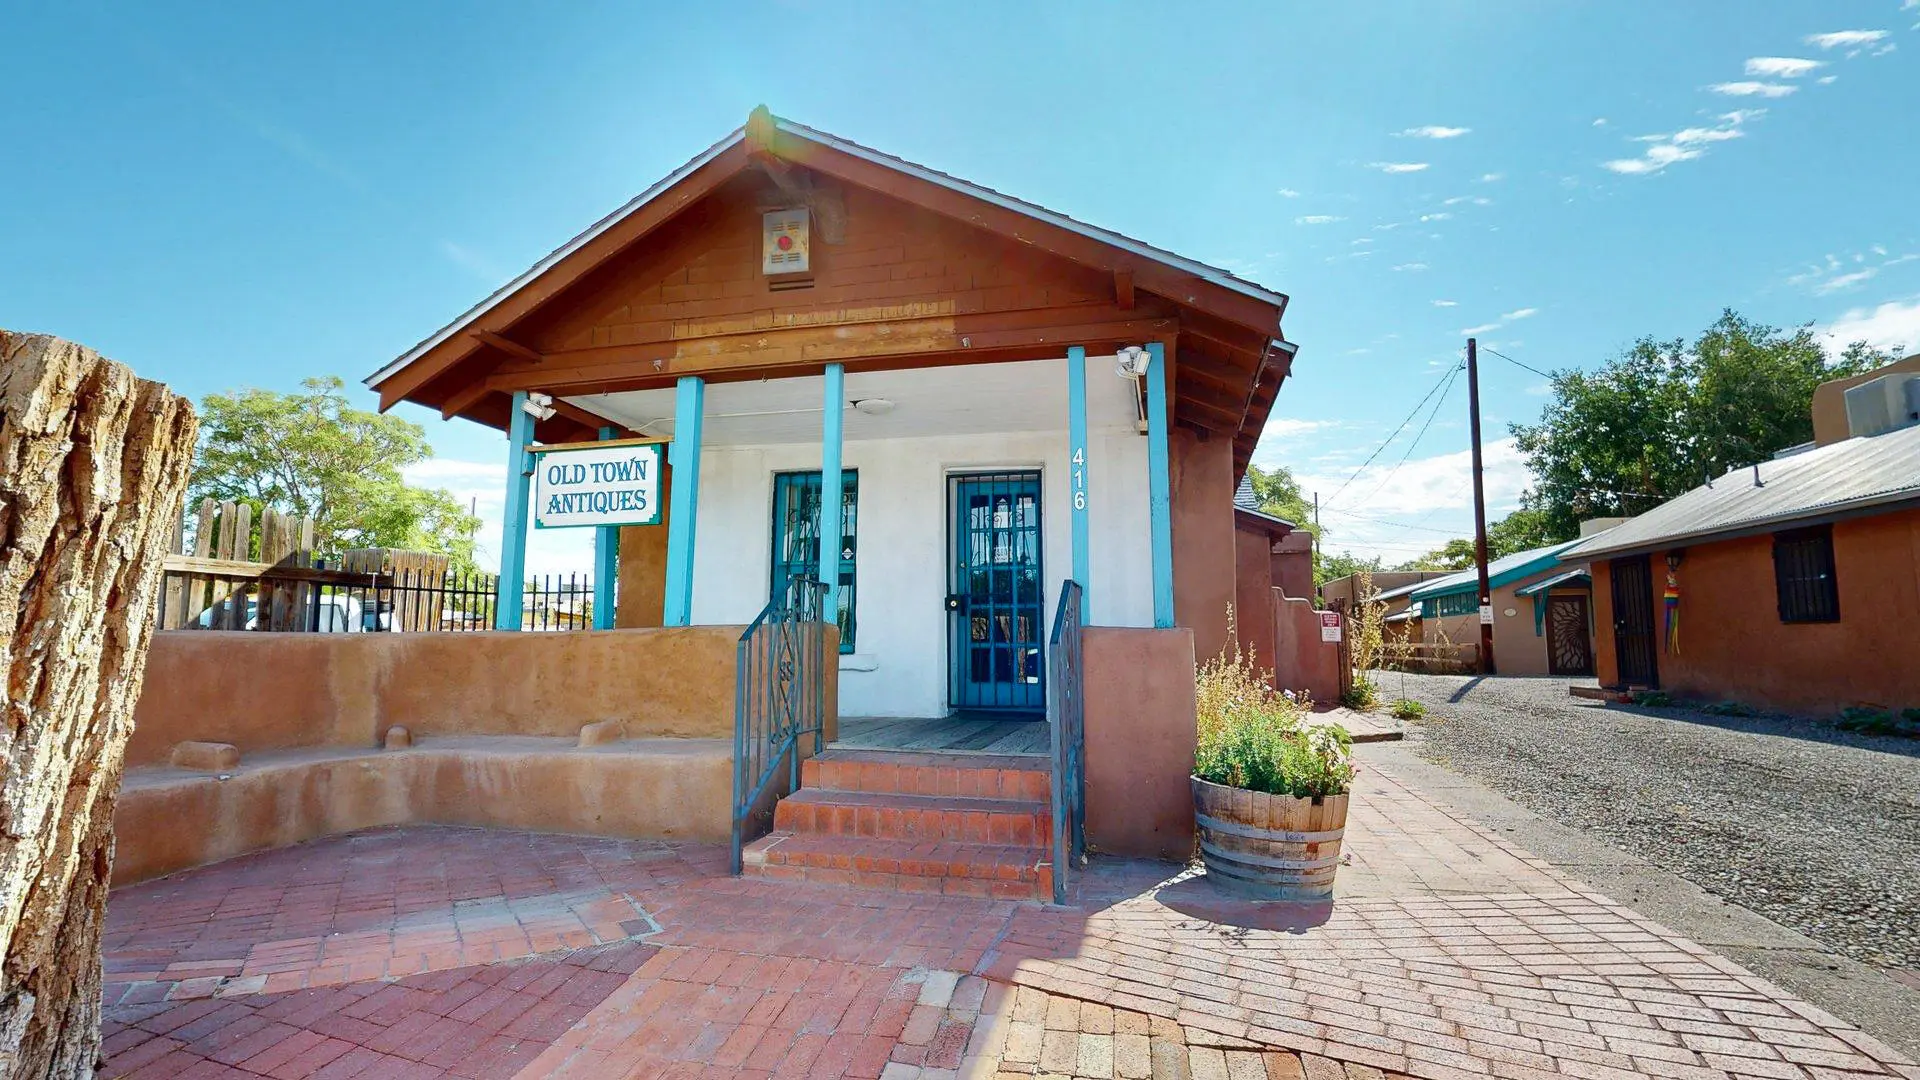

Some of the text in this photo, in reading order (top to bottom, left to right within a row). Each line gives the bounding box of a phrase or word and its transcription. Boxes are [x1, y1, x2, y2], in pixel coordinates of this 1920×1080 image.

[547, 457, 648, 486] OLD TOWN
[1072, 447, 1086, 510] 416
[546, 489, 647, 515] ANTIQUES
